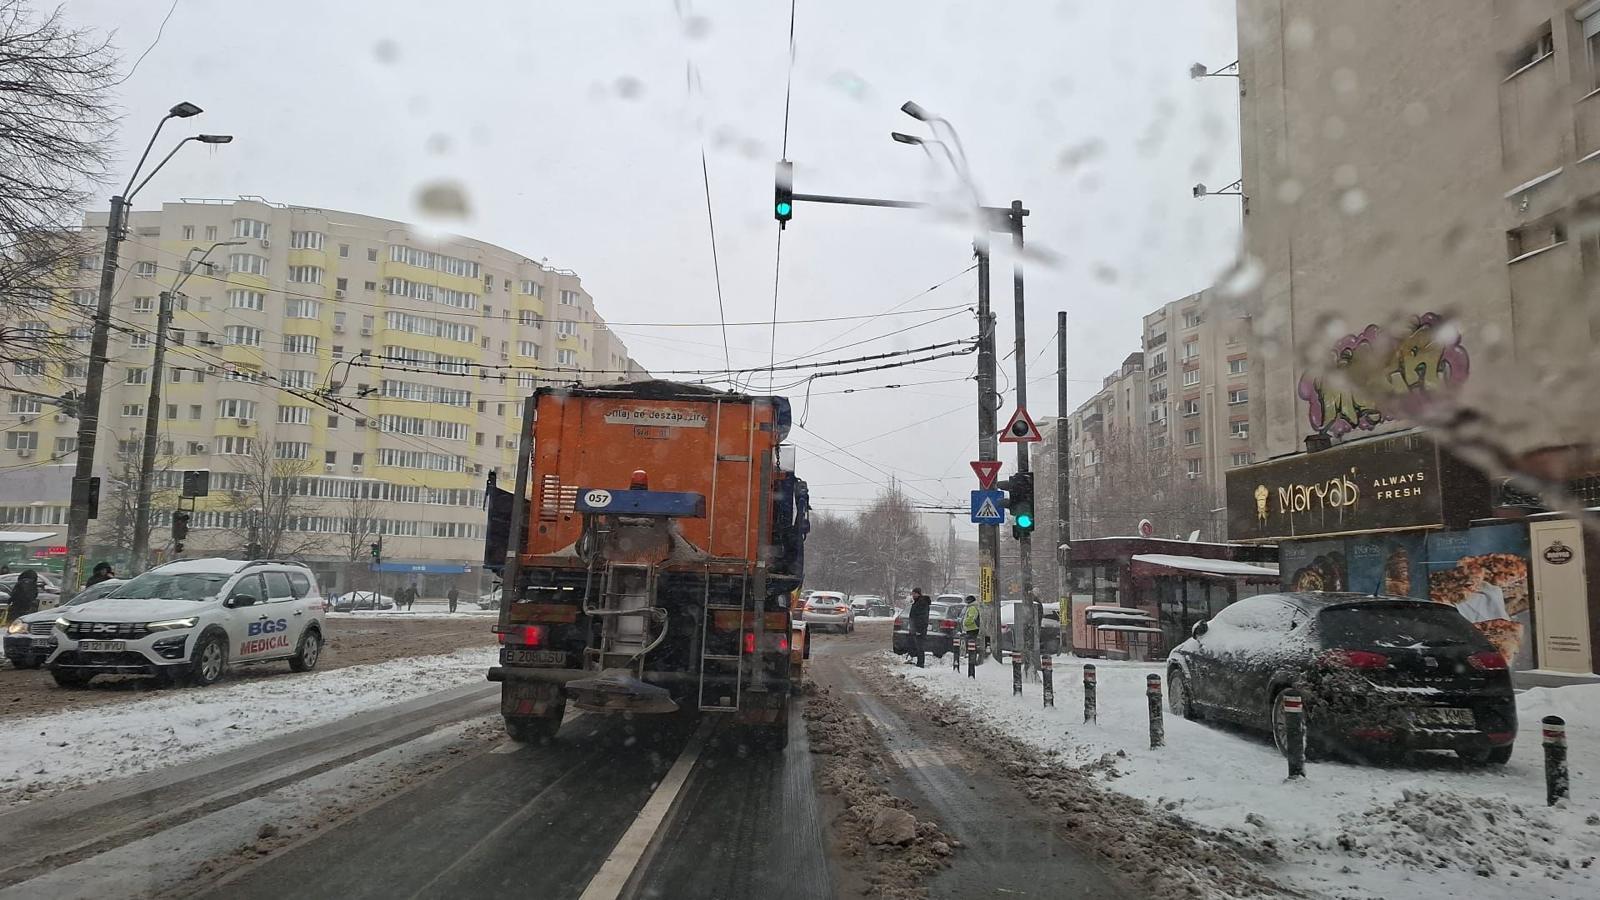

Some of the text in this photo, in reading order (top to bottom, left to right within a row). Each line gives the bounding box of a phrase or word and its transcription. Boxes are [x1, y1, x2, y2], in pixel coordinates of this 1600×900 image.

[1373, 472, 1425, 488] ALWAYS
[589, 494, 608, 503] 057
[1377, 487, 1421, 500] FRESH
[248, 618, 288, 636] BGS
[240, 635, 289, 655] MEDICAL
[507, 651, 514, 661] B
